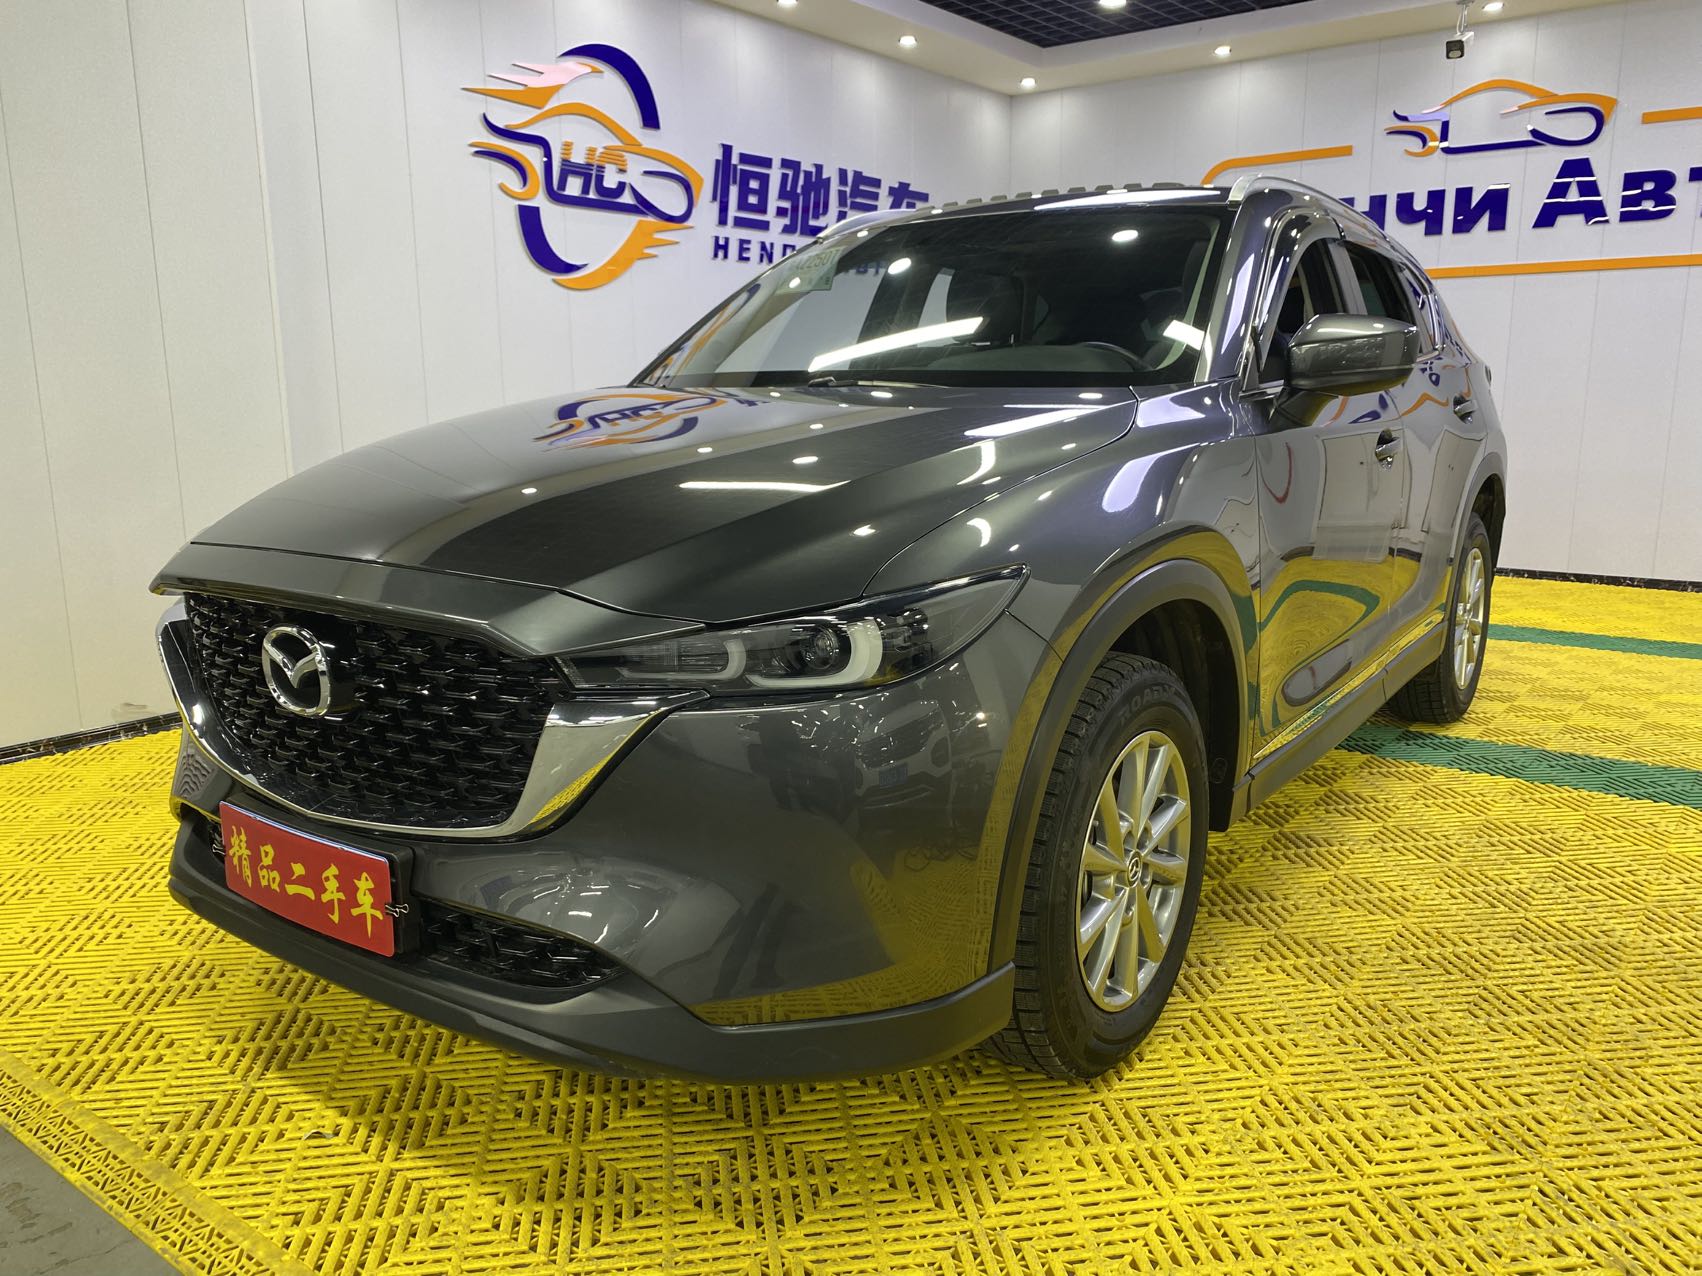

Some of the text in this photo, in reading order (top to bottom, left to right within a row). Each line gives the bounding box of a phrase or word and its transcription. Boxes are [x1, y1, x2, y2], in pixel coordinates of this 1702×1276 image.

[556, 140, 628, 199] HC
[228, 825, 384, 939] 精品二手车
